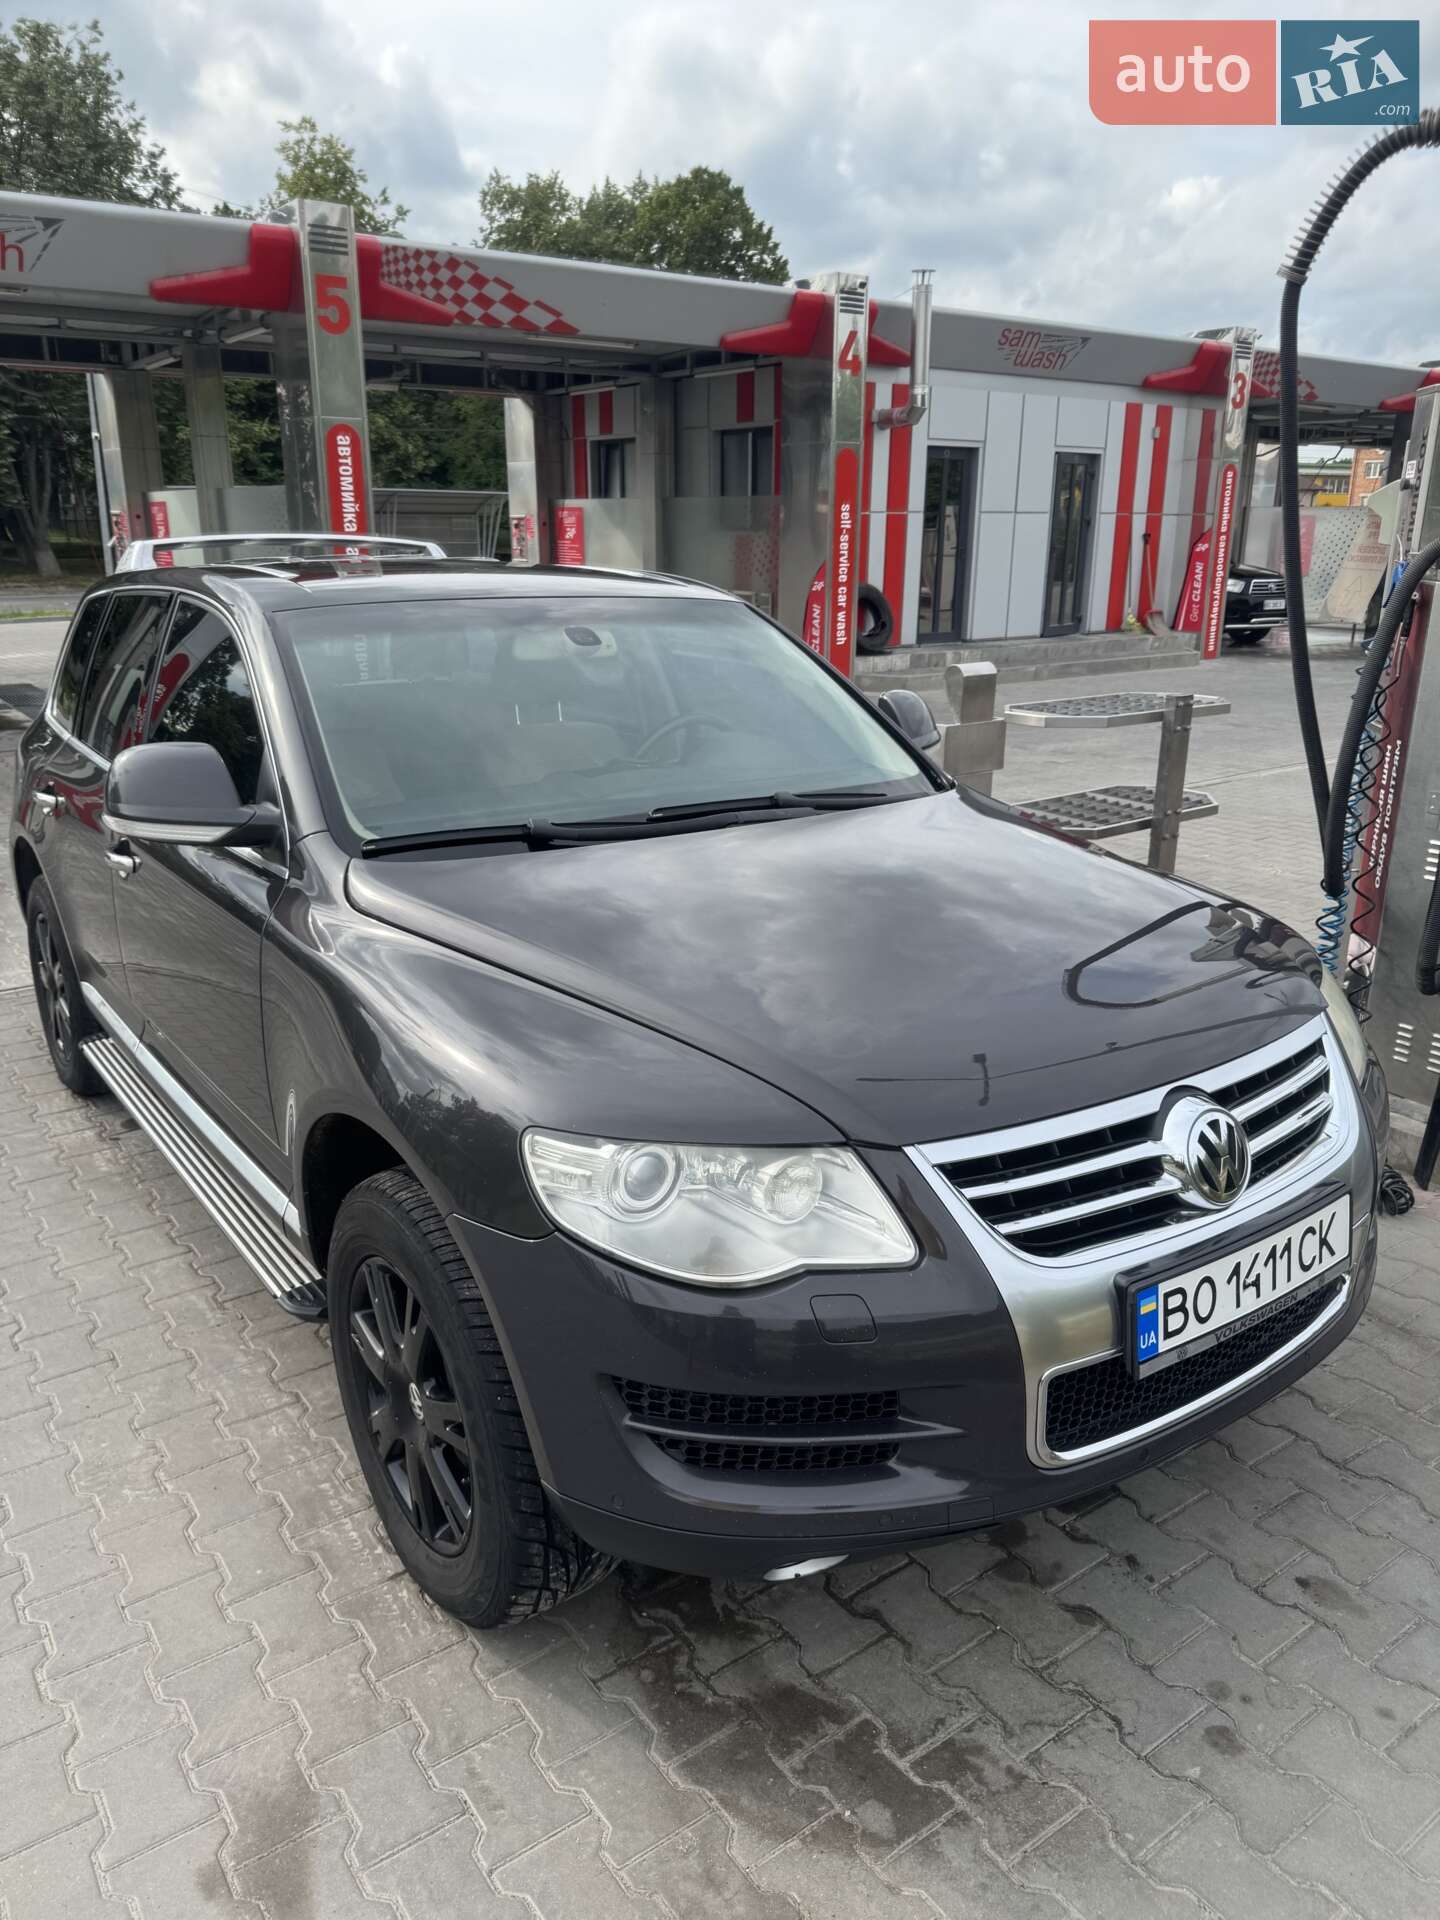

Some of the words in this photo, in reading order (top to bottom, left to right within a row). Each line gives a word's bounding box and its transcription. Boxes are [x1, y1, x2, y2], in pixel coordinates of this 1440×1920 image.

[315, 273, 352, 336] 5
[838, 330, 862, 378] 4
[998, 328, 1042, 350] sam
[1014, 346, 1068, 371] wash
[1229, 372, 1248, 410] 3
[336, 434, 360, 533] автомийка
[1221, 470, 1234, 534] автомийка
[838, 503, 852, 583] self-service
[838, 586, 848, 608] car
[1189, 603, 1201, 623] Get
[836, 609, 848, 646] wash
[1374, 832, 1388, 889] ОБДУВ
[1383, 739, 1402, 829] ПОВІТРЯМ
[1140, 1329, 1157, 1349] UA
[1214, 1291, 1299, 1344] VOLKSWAGEN
